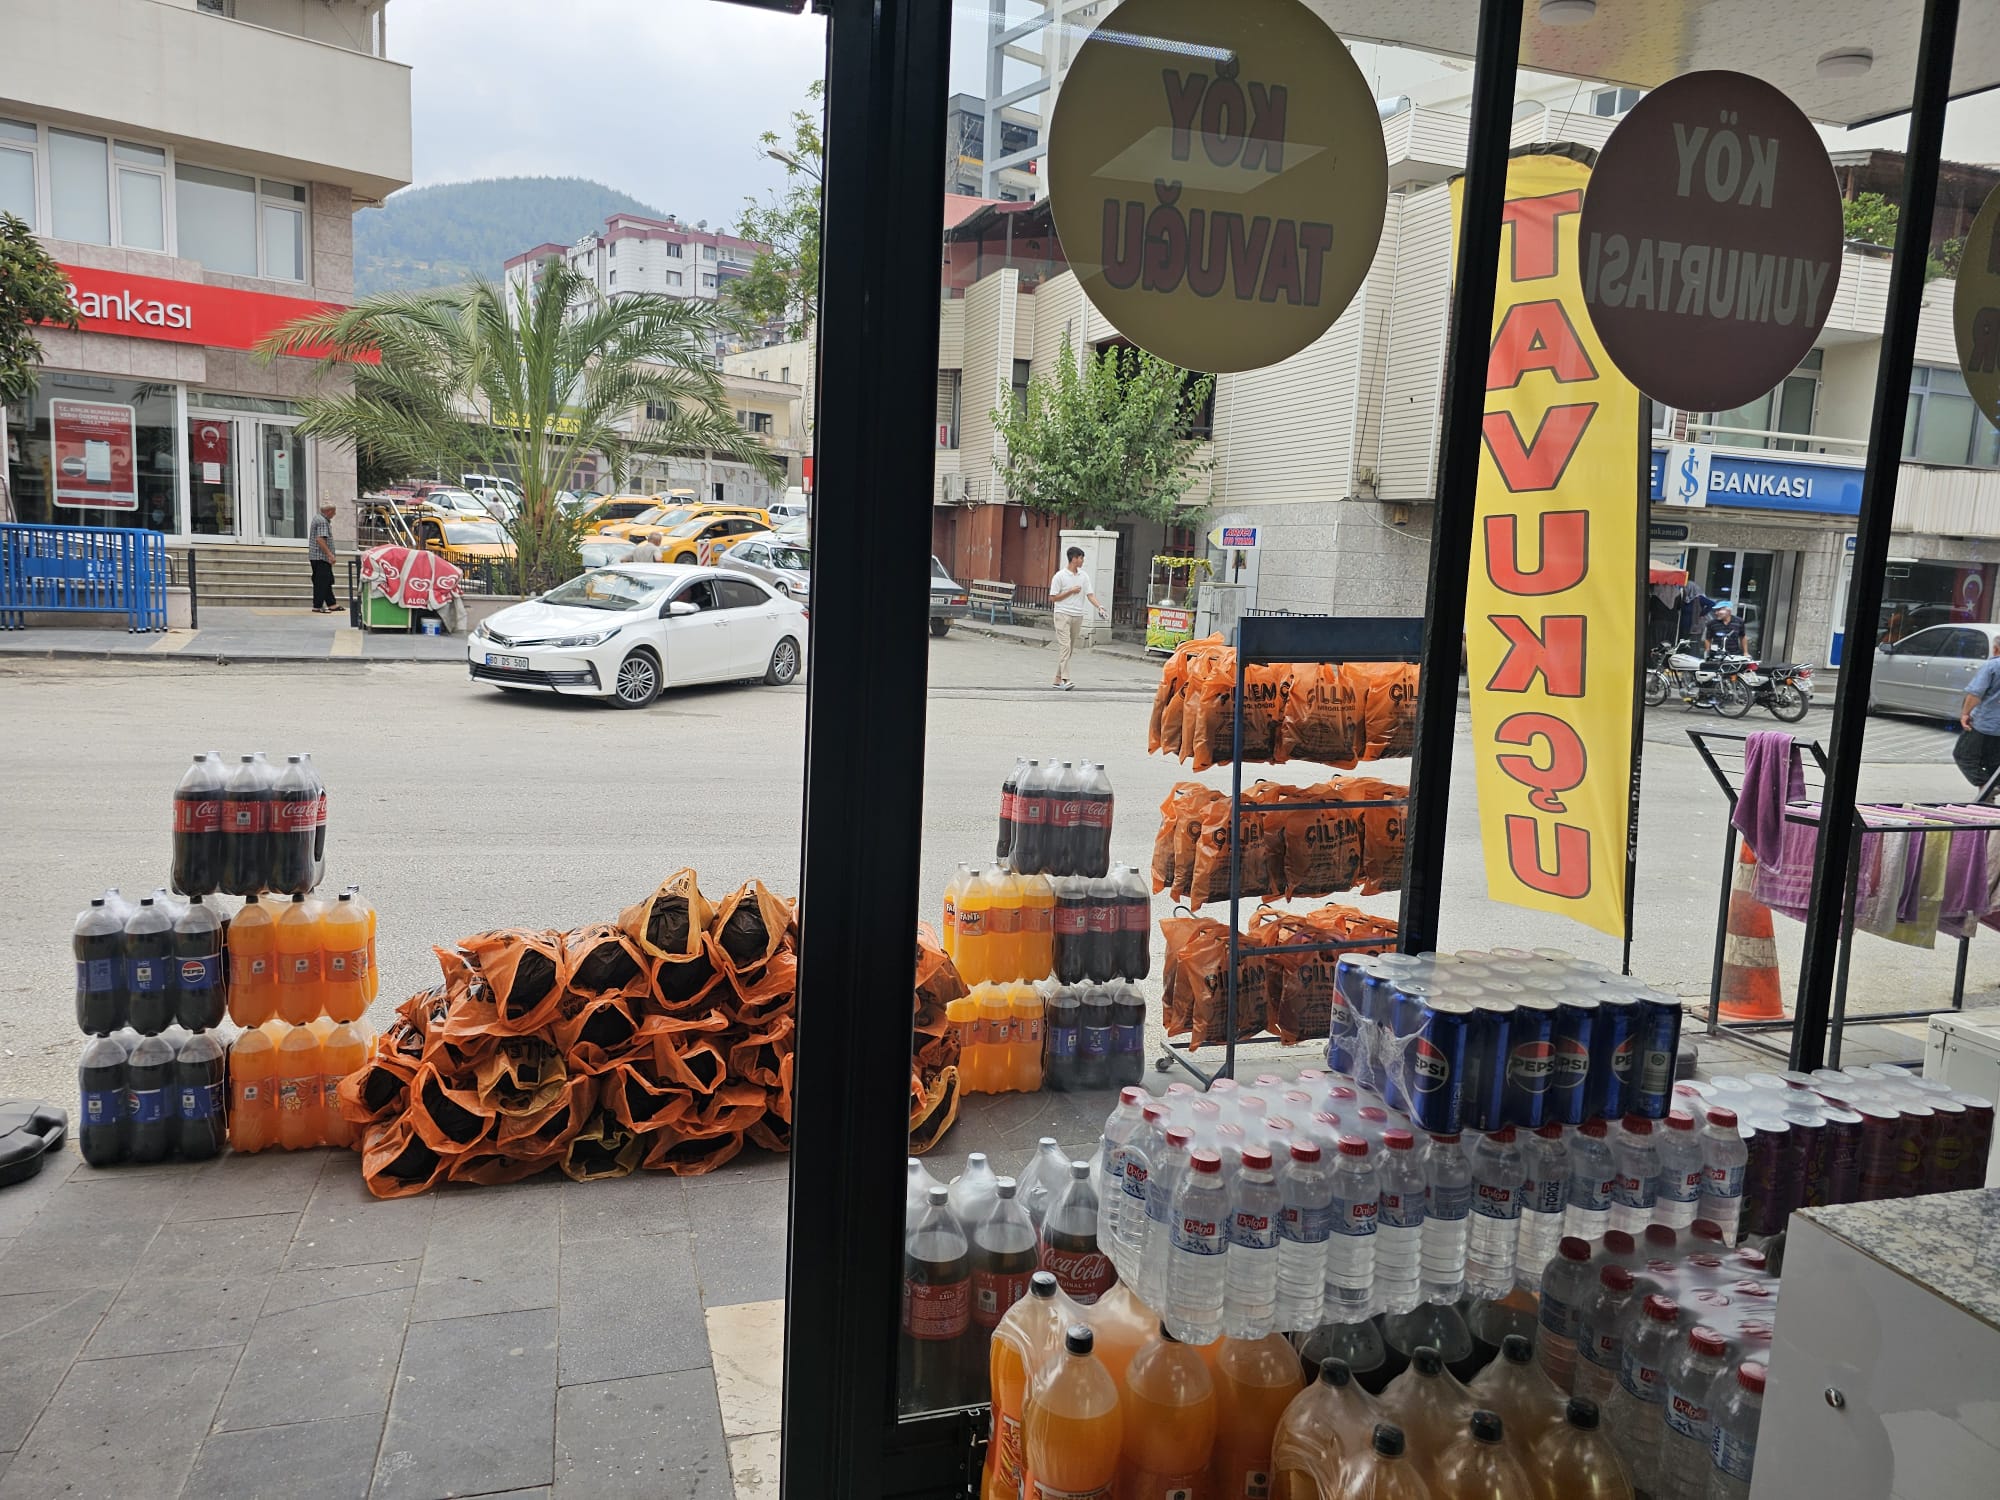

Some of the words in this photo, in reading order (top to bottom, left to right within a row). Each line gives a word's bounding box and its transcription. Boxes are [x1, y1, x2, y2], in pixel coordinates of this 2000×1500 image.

[1709, 470, 1813, 498] BANKASI
[1389, 678, 1418, 708] ÇİL
[1299, 958, 1336, 988] ÇİL
[1416, 1055, 1446, 1078] EPSI
[1512, 1060, 1555, 1074] PEPS
[1481, 1186, 1508, 1201] Dalga
[1185, 1220, 1214, 1235] Dalga
[1238, 1215, 1266, 1230] Dalga
